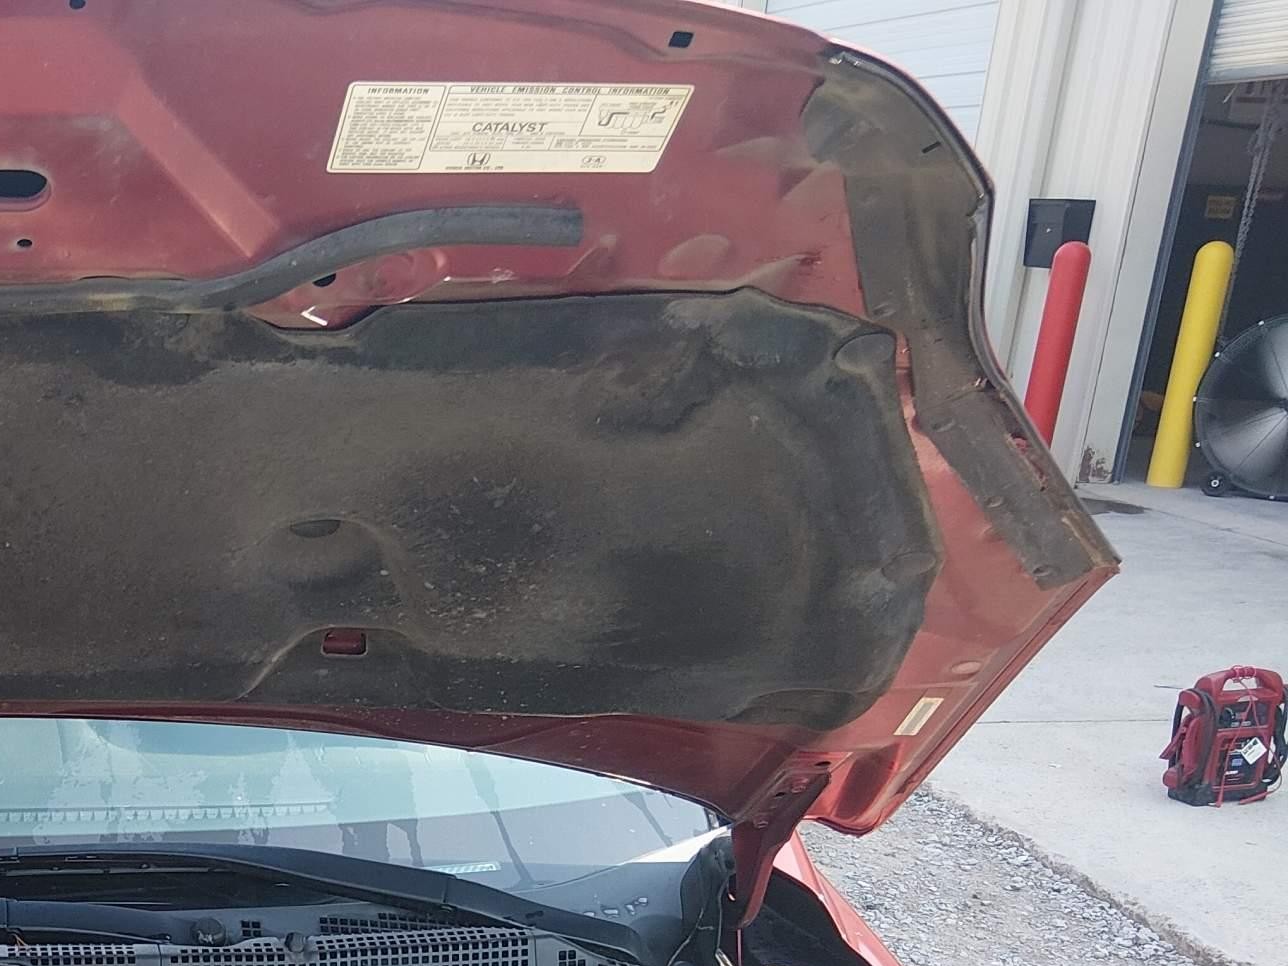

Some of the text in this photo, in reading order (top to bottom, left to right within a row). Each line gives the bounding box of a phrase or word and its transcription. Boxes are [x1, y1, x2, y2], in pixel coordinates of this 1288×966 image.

[511, 86, 556, 94] EMISSION
[562, 86, 601, 94] CONTROL
[608, 87, 670, 95] INFORMATION
[472, 122, 549, 133] CATALYST
